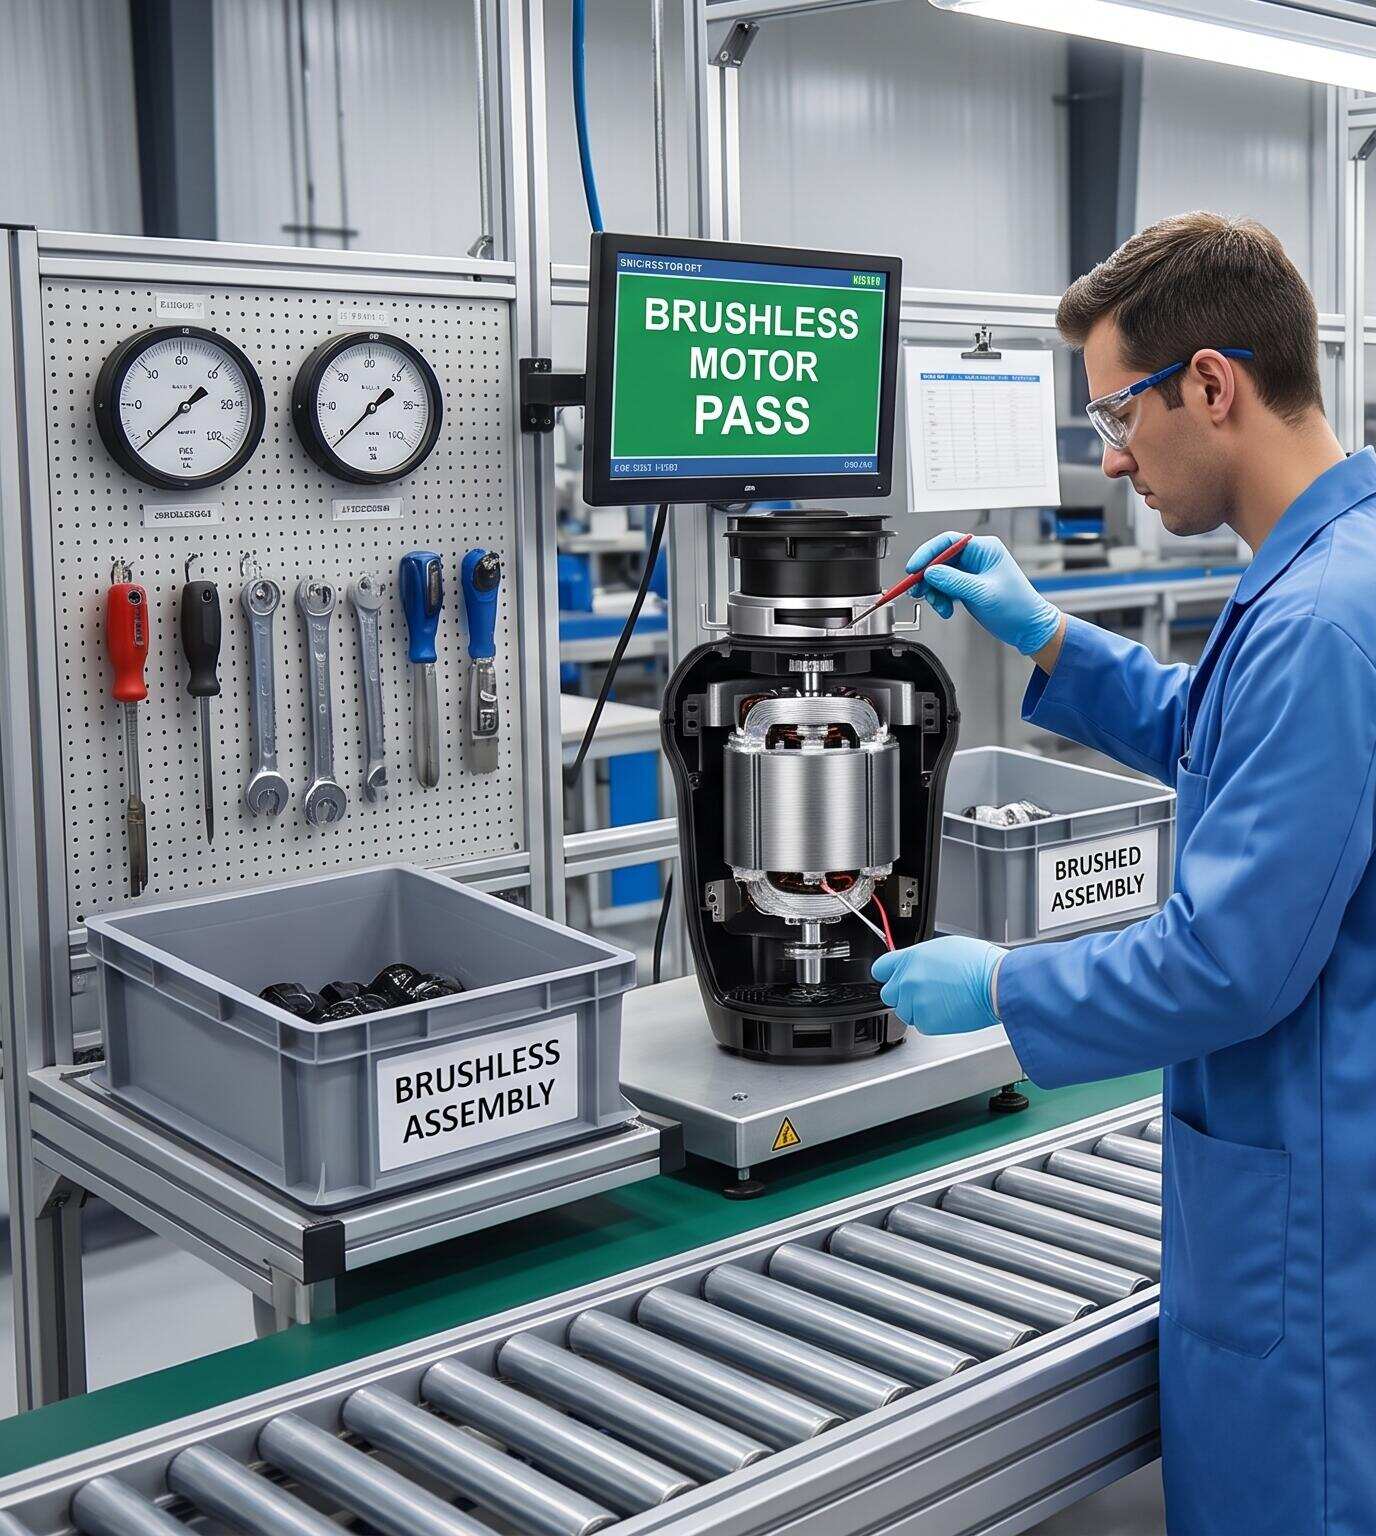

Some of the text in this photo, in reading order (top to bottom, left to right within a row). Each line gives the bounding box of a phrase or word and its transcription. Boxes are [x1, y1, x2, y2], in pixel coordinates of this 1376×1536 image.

[645, 297, 860, 340] BRUSHLESS
[690, 346, 819, 382] MOTOR
[695, 395, 810, 436] PASS
[1055, 846, 1142, 880] BRUSHED
[1051, 873, 1145, 912] ASSEMBLY
[395, 1039, 561, 1103] BRUSHLESS
[403, 1078, 555, 1143] ASSEMBLY
